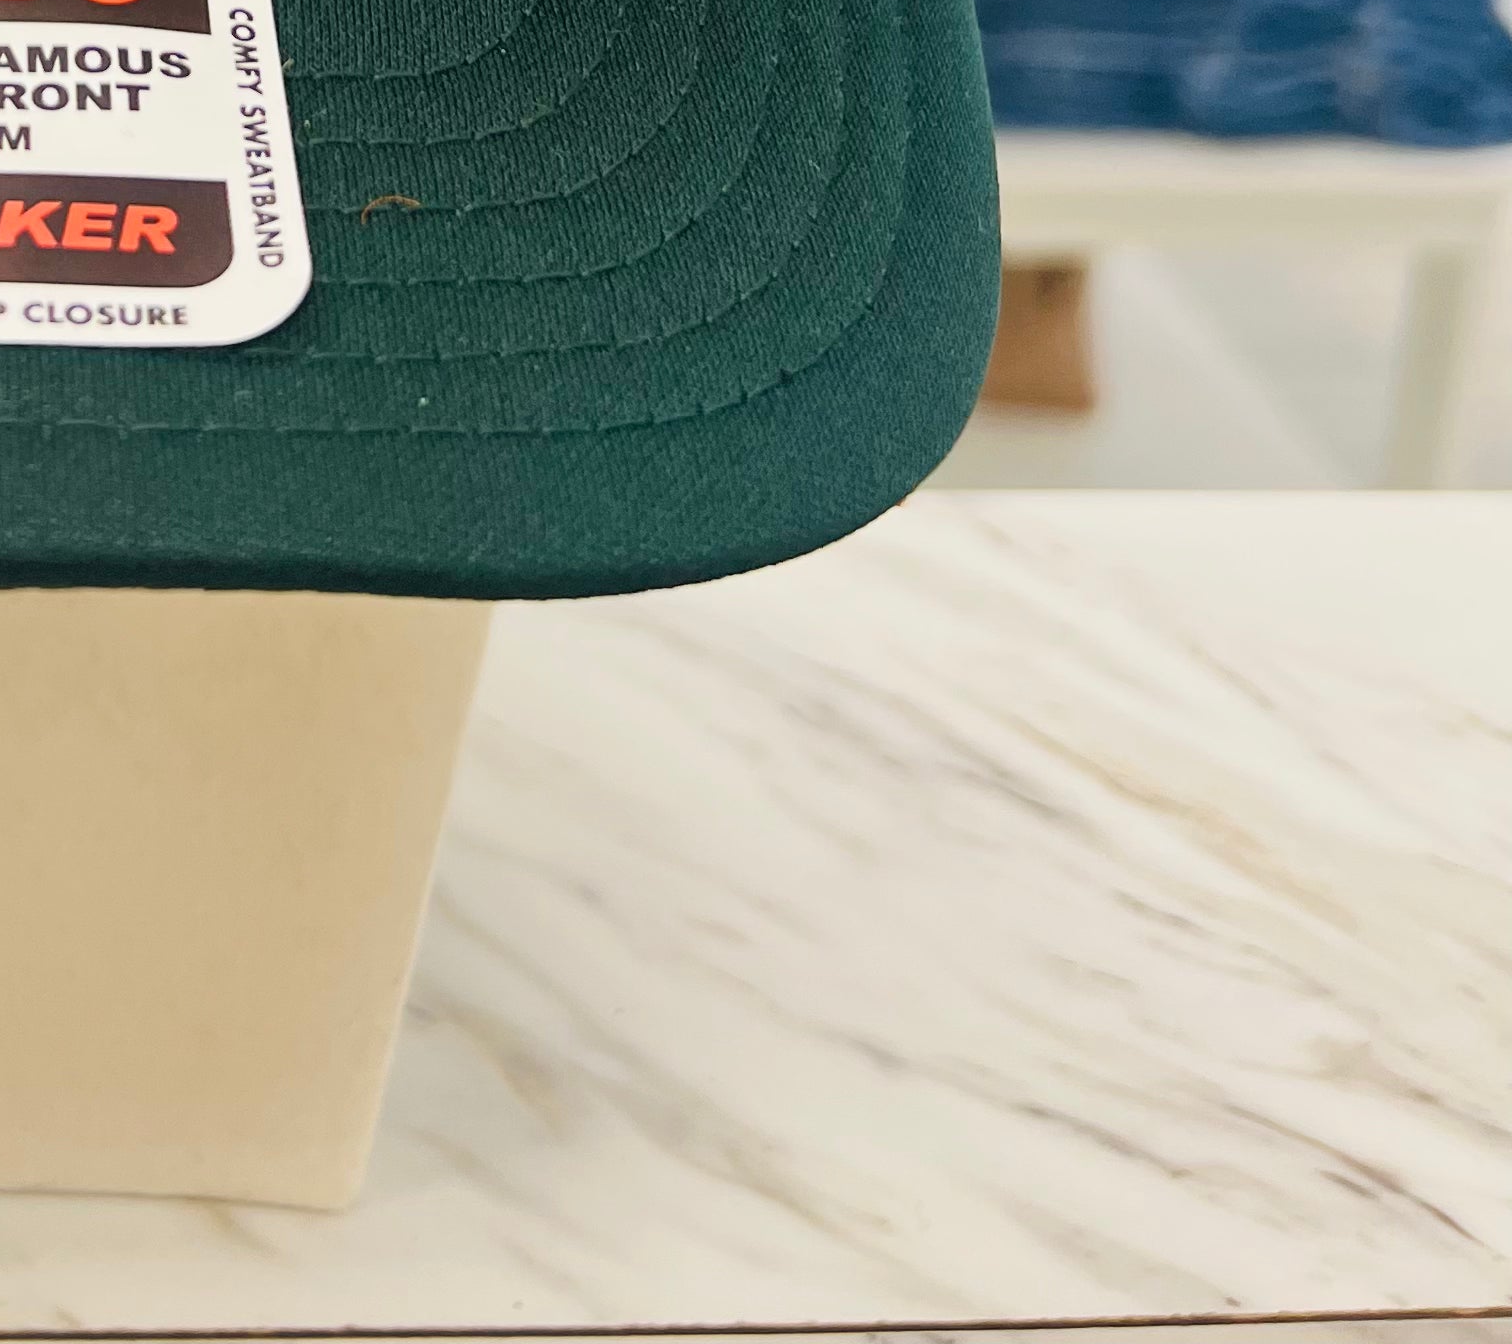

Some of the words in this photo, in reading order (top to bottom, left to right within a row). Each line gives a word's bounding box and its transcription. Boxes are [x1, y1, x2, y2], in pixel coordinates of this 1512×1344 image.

[229, 6, 265, 95] COMFY
[239, 104, 284, 270] SWEATBAND
[23, 302, 190, 328] CLOSURE
